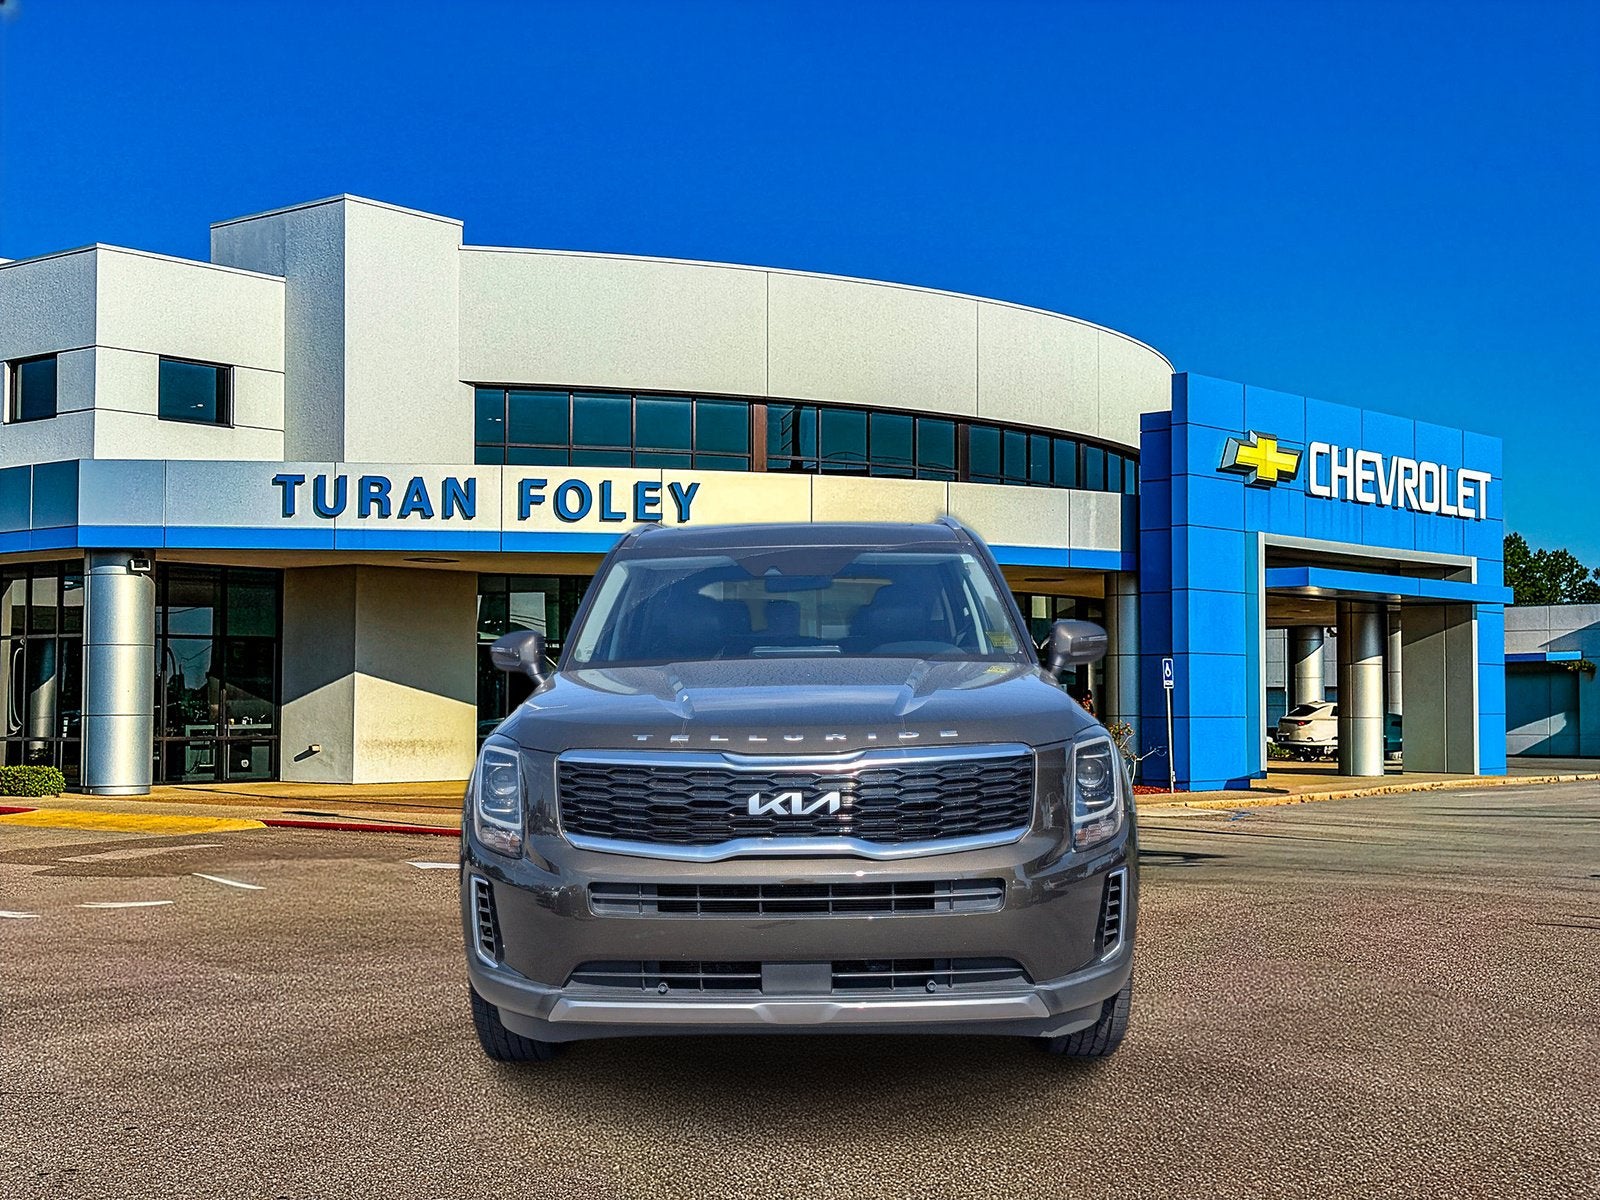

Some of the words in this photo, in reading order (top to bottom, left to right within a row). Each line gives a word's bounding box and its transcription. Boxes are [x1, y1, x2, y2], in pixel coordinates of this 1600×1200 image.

[272, 473, 477, 520] TURAN
[517, 478, 701, 523] FOLEY
[1308, 441, 1492, 520] CHEVROLET
[633, 729, 959, 742] TELLURIDE
[747, 790, 841, 816] KIA
